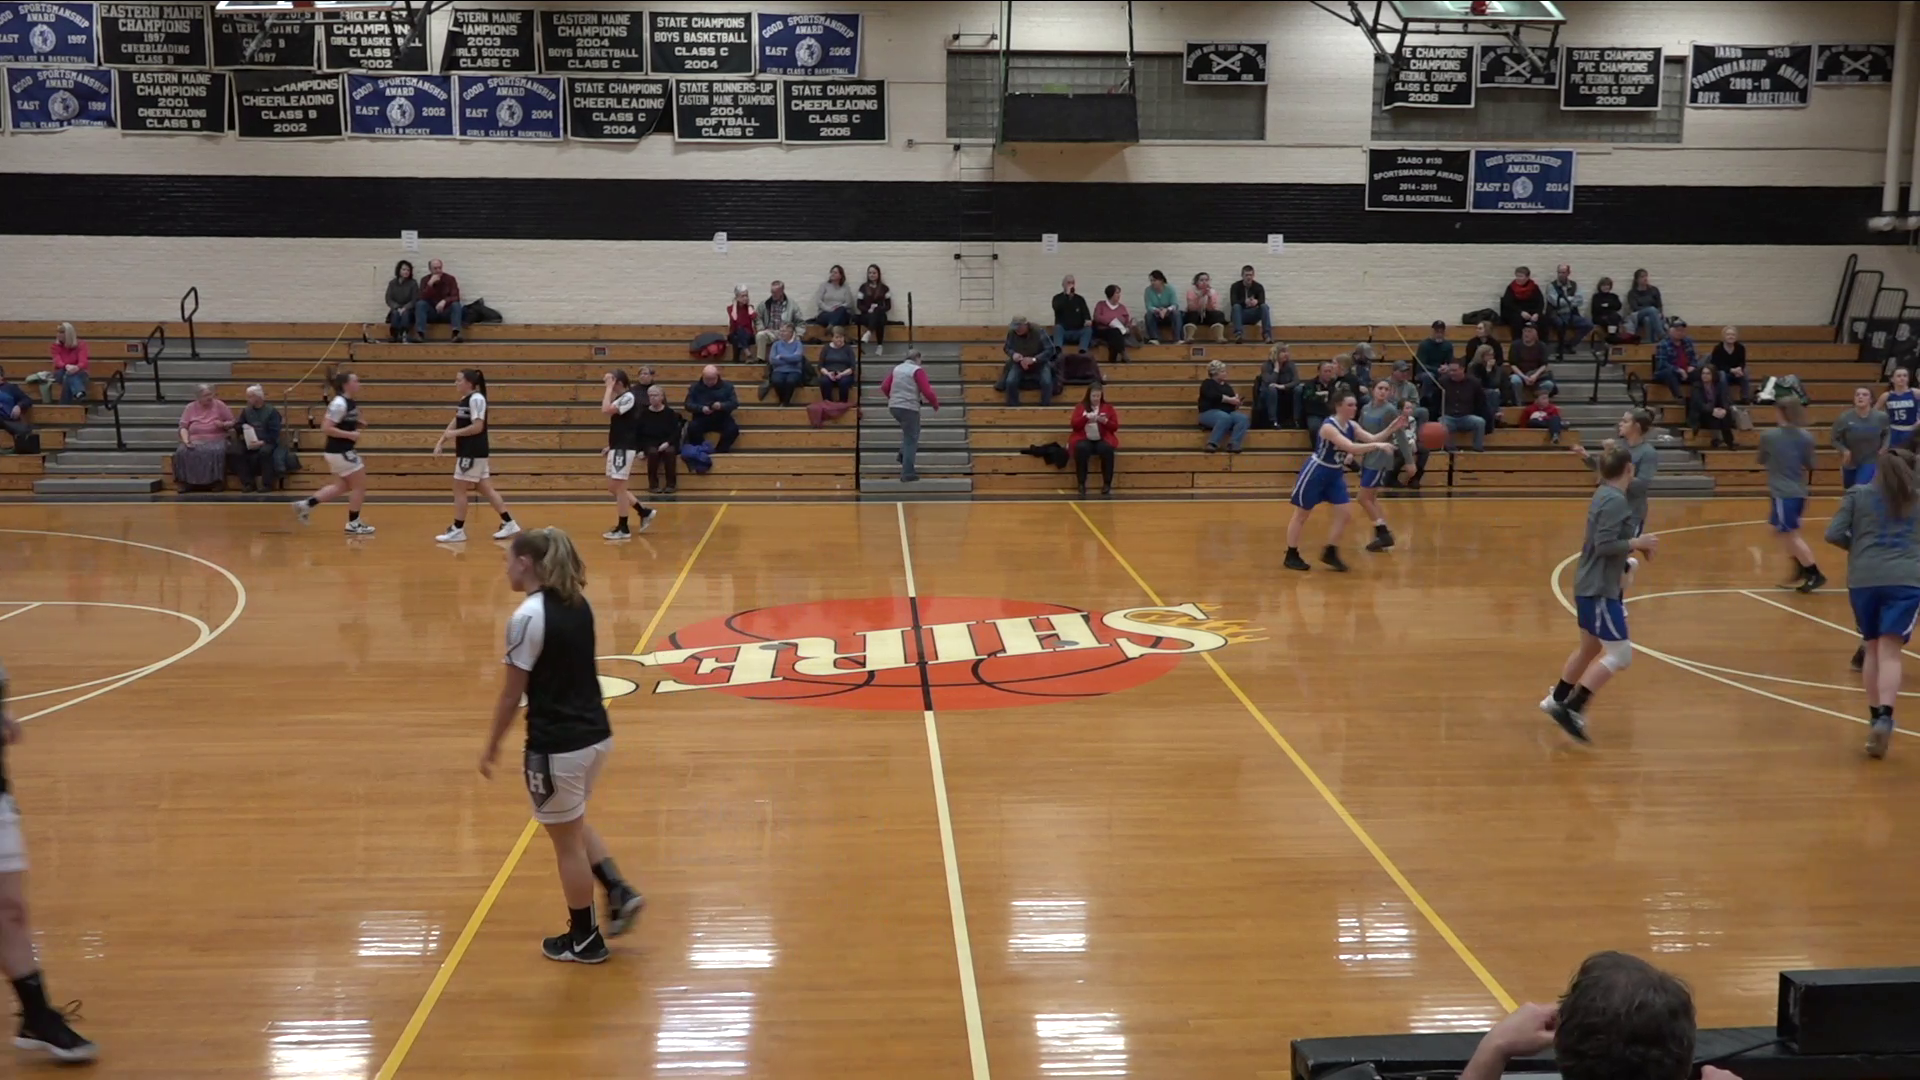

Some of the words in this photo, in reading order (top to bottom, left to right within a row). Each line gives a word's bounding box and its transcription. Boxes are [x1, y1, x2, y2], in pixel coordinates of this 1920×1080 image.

[18, 3, 90, 28] SPORTSMANSHIP
[101, 5, 160, 18] EASTERN
[163, 6, 203, 19] MAINE
[27, 13, 56, 22] AWARD
[456, 12, 488, 23] STERN
[492, 12, 522, 23] MAINE
[553, 14, 598, 25] EASTERN
[601, 14, 631, 25] MAINE
[657, 17, 688, 28] STATE
[691, 17, 745, 28] CHAMPIONS
[119, 19, 190, 33] CHAMPIONS
[762, 21, 784, 38] GOOD
[787, 15, 855, 39] SPORTSMANSHIP
[795, 25, 824, 35] AWARD
[557, 26, 628, 37] CHAMPIONS
[68, 35, 87, 44] 1997
[143, 33, 166, 42] 1997
[331, 37, 357, 46] GIRLS
[467, 37, 501, 46] 2003
[576, 38, 610, 47] 2004
[654, 32, 680, 42] BOYS
[683, 32, 748, 43] BASKETBALL
[121, 44, 190, 54] CHEERLEADING
[349, 48, 391, 57] CLASS
[481, 48, 519, 57] SOCCER
[548, 48, 573, 57] BOYS
[577, 48, 639, 58] BASKETBALL
[674, 47, 716, 56] CLASS
[720, 47, 729, 56] C
[765, 46, 788, 56] EAST
[1416, 48, 1468, 59] CHAMPIONS
[135, 54, 163, 64] CLASS
[1572, 50, 1600, 60] STATE
[1604, 50, 1654, 61] CHAMPIONS
[360, 60, 393, 69] 2002
[460, 58, 499, 68] CLASS
[502, 59, 511, 68] C
[568, 59, 608, 68] CLASS
[612, 59, 621, 68] C
[684, 60, 719, 69] 2004
[1410, 59, 1461, 70] CHAMPIONS
[1600, 62, 1648, 73] CHAMPIONS
[132, 73, 178, 84] EASTERN
[182, 73, 212, 85] MAINE
[1692, 59, 1767, 89] SPORTSMANSHIP
[1777, 64, 1808, 89] AWARD
[12, 76, 33, 93] GOOD
[37, 70, 109, 94] SPORTSMANSHIP
[45, 79, 74, 88] AWARD
[136, 85, 207, 96] CHAMPIONS
[352, 83, 374, 100] GOOD
[377, 77, 448, 101] SPORTSMANSHIP
[385, 87, 415, 96] AWARD
[463, 82, 485, 100] GOOD
[487, 76, 556, 101] SPORTSMANSHIP
[496, 87, 525, 96] AWARD
[574, 83, 605, 93] STATE
[609, 83, 663, 94] CHAMPIONS
[679, 82, 709, 93] STATE
[713, 82, 774, 93] RUNNERS-UP
[791, 85, 823, 96] STATE
[826, 85, 877, 96] CHAMPIONS
[1423, 84, 1430, 92] C
[1434, 84, 1458, 92] GOLF
[1579, 85, 1609, 95] CLASS
[1611, 86, 1619, 95] C
[1620, 86, 1645, 95] GOLF
[158, 98, 189, 107] 2001
[242, 94, 334, 106] CHEERLEADING
[679, 95, 709, 105] EASTERN
[713, 95, 734, 105] MAINE
[738, 95, 775, 106] CHAMPIONS
[1697, 91, 1720, 104] BOYS
[1746, 92, 1799, 104] BASKETBALL
[17, 101, 39, 110] EAST
[573, 97, 665, 109] CHEERLEADING
[791, 100, 878, 111] CHEERLEADING
[138, 108, 207, 118] CHEERLEADING
[261, 110, 303, 119] CLASS
[308, 110, 317, 119] B
[355, 105, 380, 116] EAST
[422, 107, 446, 116] 2002
[465, 108, 488, 118] EAST
[531, 110, 553, 119] 2004
[710, 107, 743, 116] 2004
[592, 113, 634, 121] CLASS
[638, 113, 646, 122] C
[695, 117, 760, 126] SOFTBALL
[808, 114, 848, 123] CLASS
[852, 114, 861, 123] C
[146, 119, 188, 128] CLASS
[192, 120, 200, 128] B
[273, 123, 307, 132] 2002
[518, 130, 553, 138] BASKETBALL
[603, 125, 636, 134] 2004
[701, 127, 742, 137] CLASS
[745, 128, 754, 137] C
[1504, 153, 1562, 167] SPORTSMANSHIP
[1506, 164, 1541, 173] AWARD
[1373, 169, 1436, 180] SPORTSMANSHIP
[1437, 171, 1464, 182] AWARD
[1475, 183, 1502, 192] EAST
[1503, 183, 1510, 192] D
[1545, 183, 1569, 192] 2014
[1382, 194, 1404, 202] GIRLS
[1405, 194, 1453, 203] BASKETBALL
[1498, 201, 1545, 209] FOOTBALL
[1894, 409, 1906, 420] 15
[527, 770, 546, 794] H
